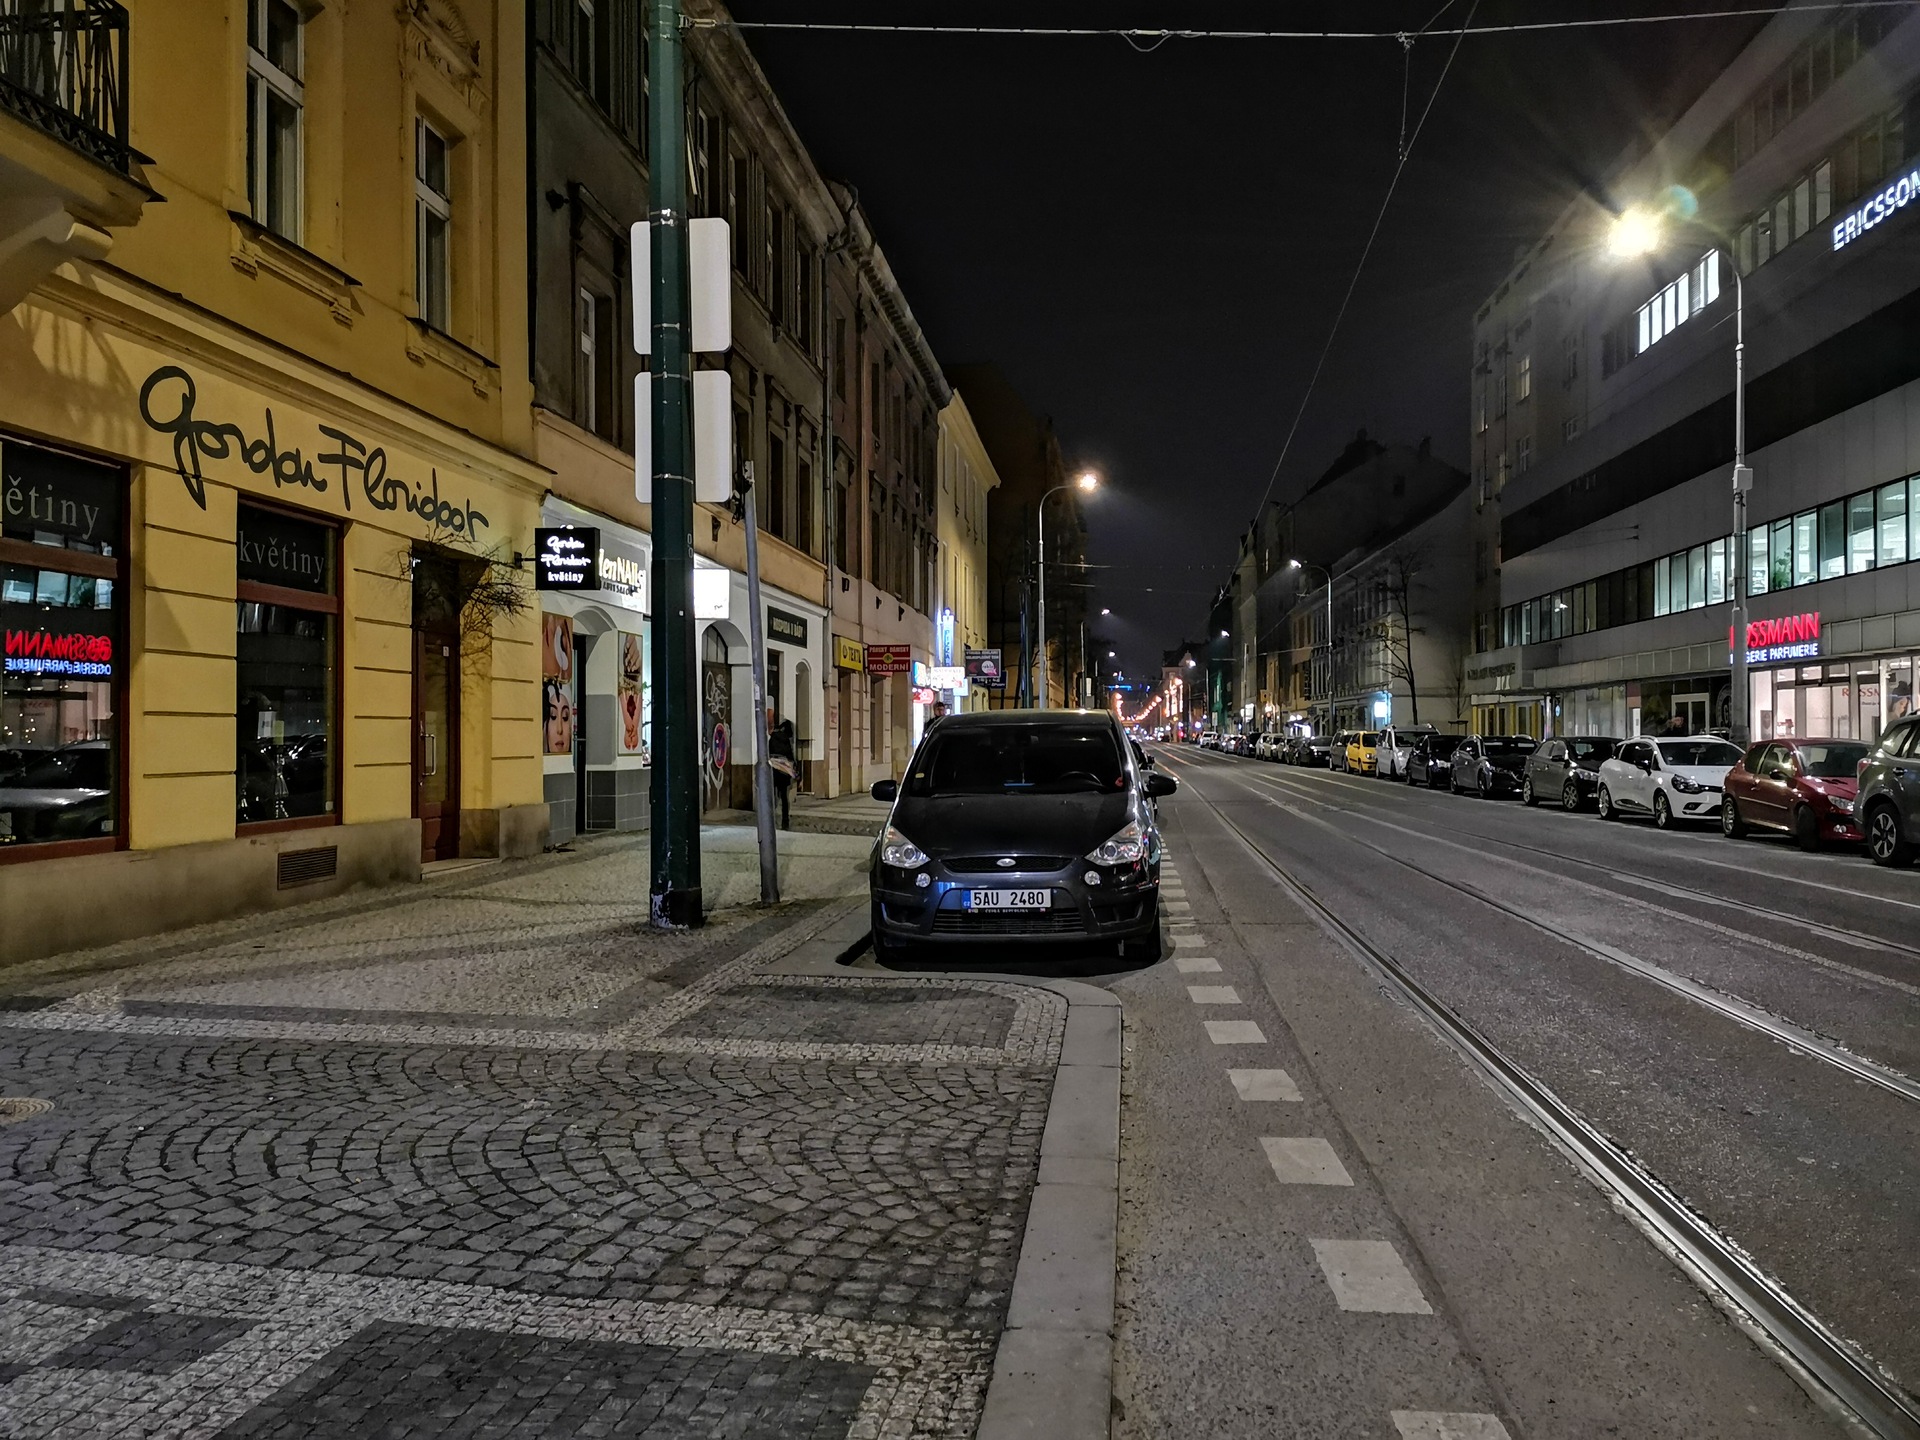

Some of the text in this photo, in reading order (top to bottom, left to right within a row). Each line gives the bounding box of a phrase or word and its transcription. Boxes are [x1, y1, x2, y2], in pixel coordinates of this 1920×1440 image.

[238, 530, 325, 584] květiny
[547, 571, 584, 583] květiny
[869, 662, 909, 671] MODERNÍ
[973, 891, 1044, 906] 5AU 2480
